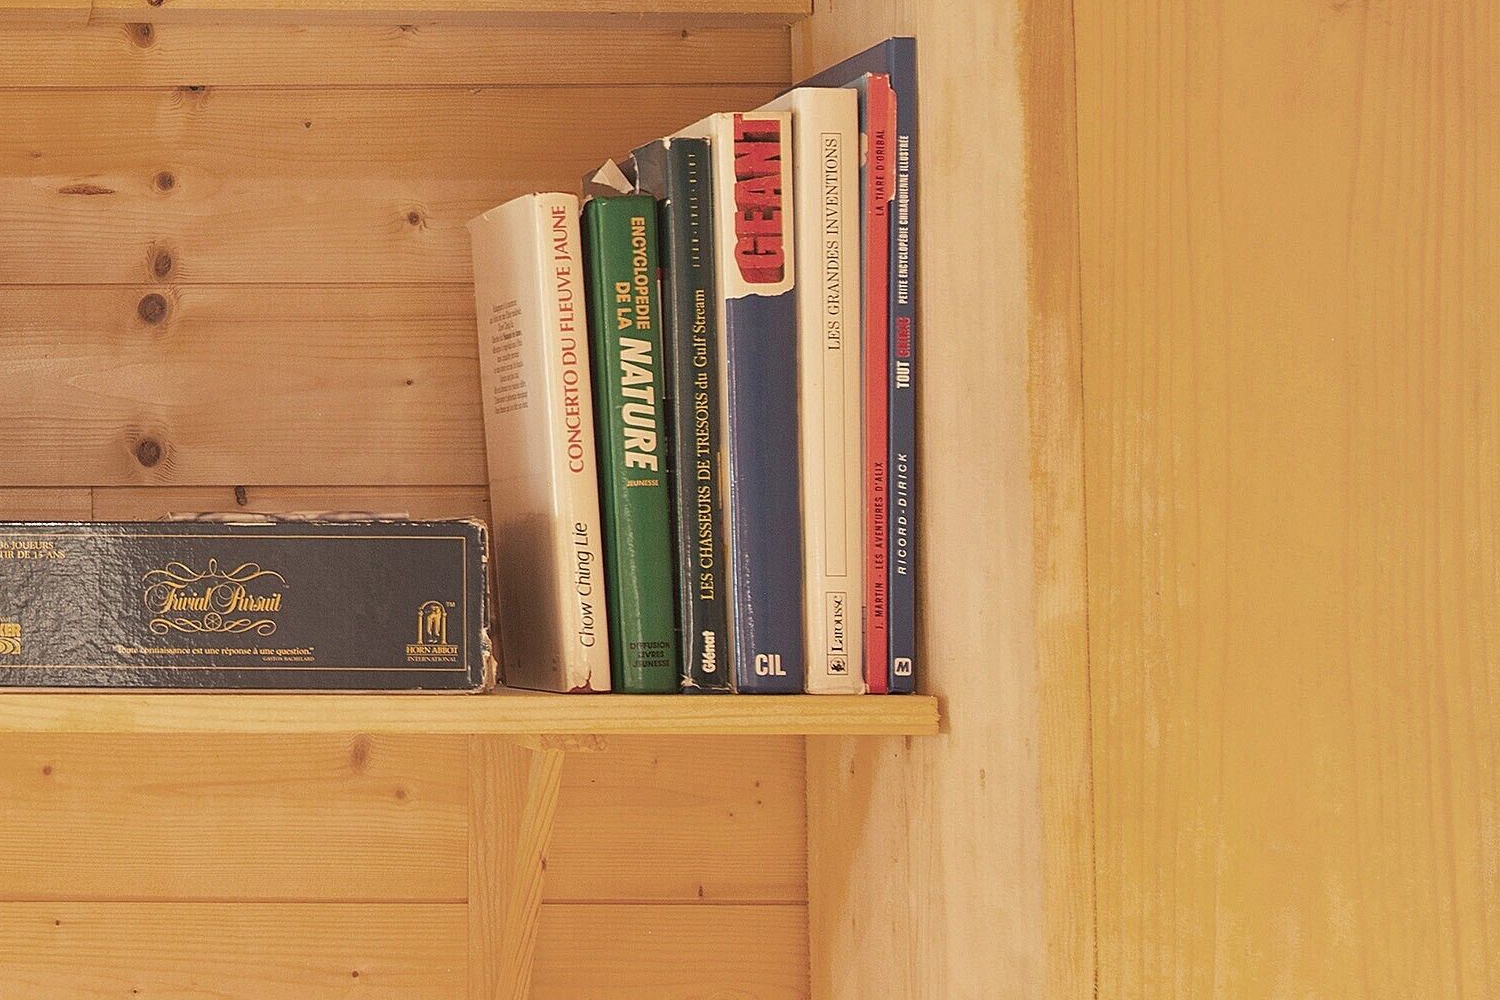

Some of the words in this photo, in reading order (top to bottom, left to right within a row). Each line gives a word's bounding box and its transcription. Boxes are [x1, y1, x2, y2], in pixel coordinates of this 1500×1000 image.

[876, 130, 885, 170] D'ORIBAL
[899, 135, 909, 172] ILLUSTRÉE
[733, 114, 785, 284] GEANT
[825, 138, 839, 234] INVENTIONS
[876, 176, 885, 201] TIARE
[899, 173, 909, 225] CHIRAQUIENNE
[876, 206, 884, 216] LA
[551, 205, 573, 260] JAUNE
[898, 227, 909, 278] ENCYCLOPÉDIE
[615, 281, 631, 303] DE
[630, 216, 650, 330] ENCYCLOPEDIE
[826, 240, 840, 316] GRANDES
[898, 279, 908, 304] PETITE
[556, 266, 574, 332] FLEUVE
[617, 305, 633, 330] LA
[693, 289, 706, 334] Stream
[561, 338, 578, 366] DU
[693, 335, 707, 367] Gulf
[828, 321, 840, 350] LES
[694, 373, 708, 389] du
[896, 361, 910, 388] TOUT
[562, 369, 584, 473] CONCERTO
[619, 337, 659, 472] NATURE
[696, 393, 710, 456] TRESORS
[697, 459, 710, 481] DE
[875, 463, 883, 491] D'ALIX
[572, 522, 588, 547] Lie
[698, 485, 713, 569] CHASSEURS
[875, 497, 883, 548] AVENTURES
[575, 551, 594, 596] Ching
[875, 554, 883, 569] LES
[144, 581, 212, 614] Trivial
[210, 581, 282, 615] Pursuit
[700, 575, 714, 601] LES
[875, 582, 883, 617] MARTIN
[578, 602, 595, 648] Chow
[831, 595, 843, 651] Larousse
[702, 631, 715, 673] Glénat
[755, 654, 786, 676] CIL
